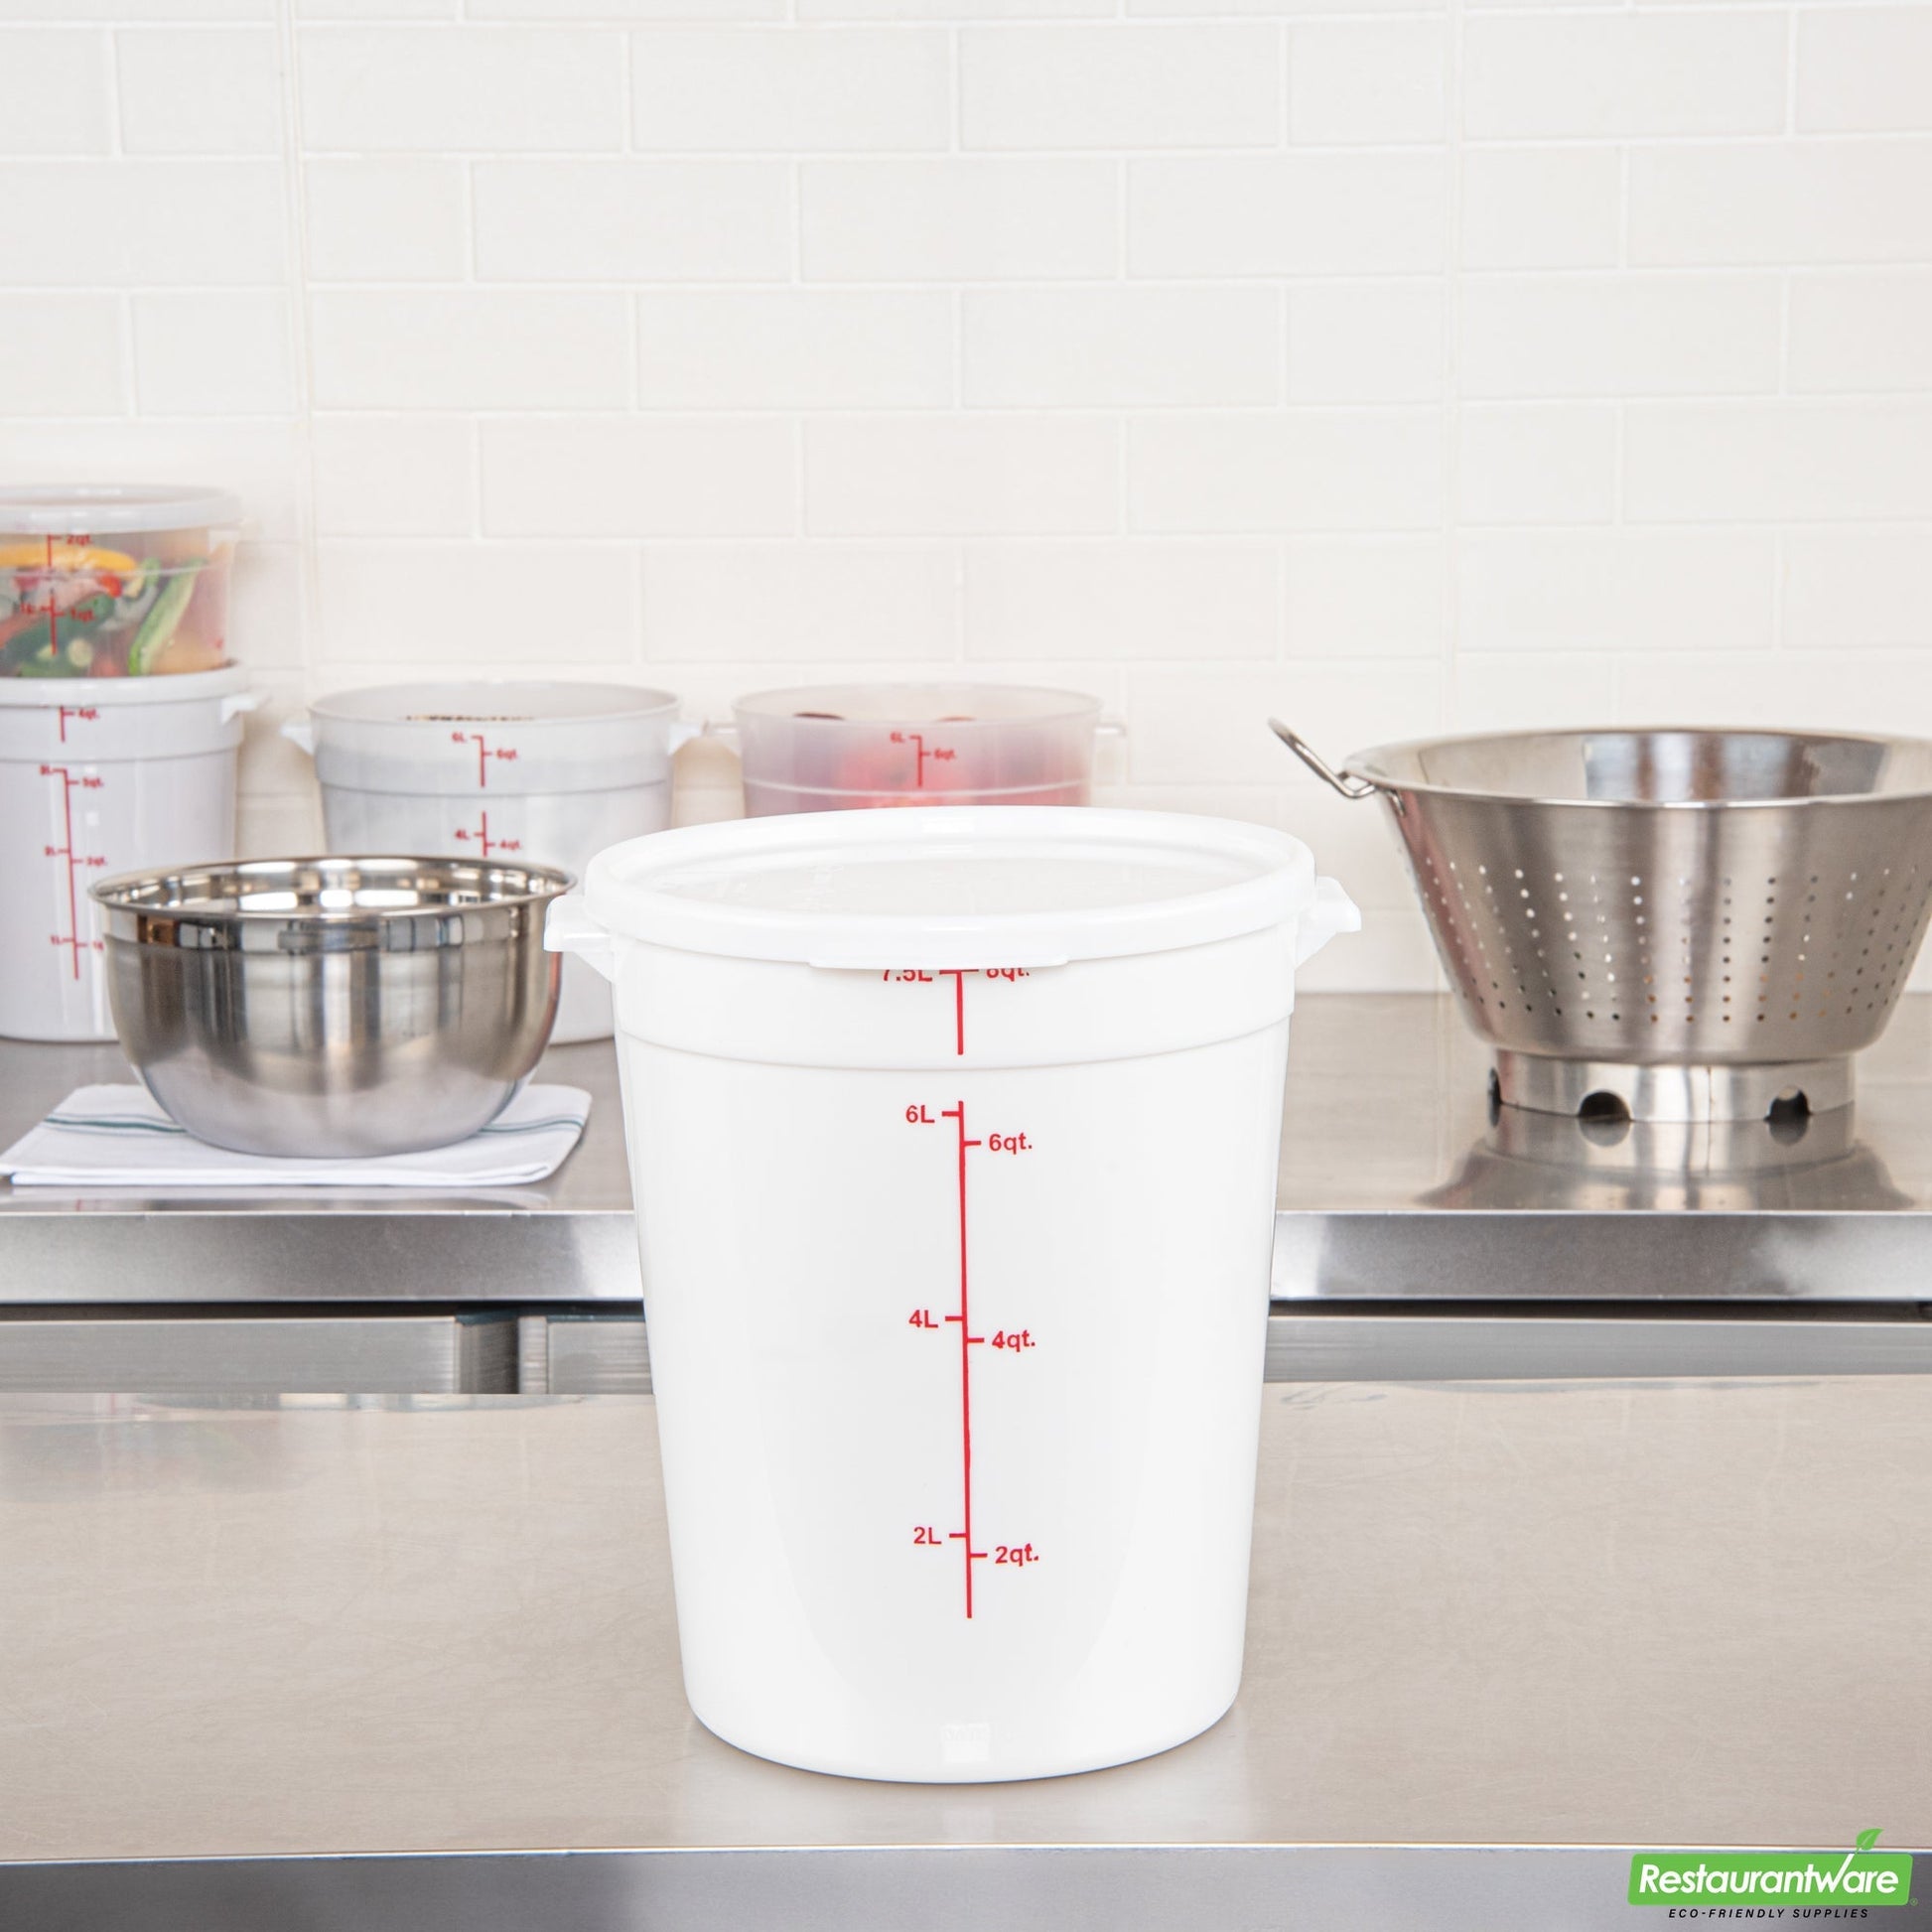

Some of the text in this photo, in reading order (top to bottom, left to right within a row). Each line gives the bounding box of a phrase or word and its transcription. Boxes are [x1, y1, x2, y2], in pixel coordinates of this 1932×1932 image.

[883, 969, 933, 983] 7.5L
[905, 1104, 936, 1124] 6L
[989, 1132, 1034, 1156] 6qt.
[908, 1310, 939, 1328] 4L
[991, 1329, 1035, 1353] 4qt.
[912, 1526, 942, 1546] 2L
[995, 1543, 1039, 1568] 2qt.
